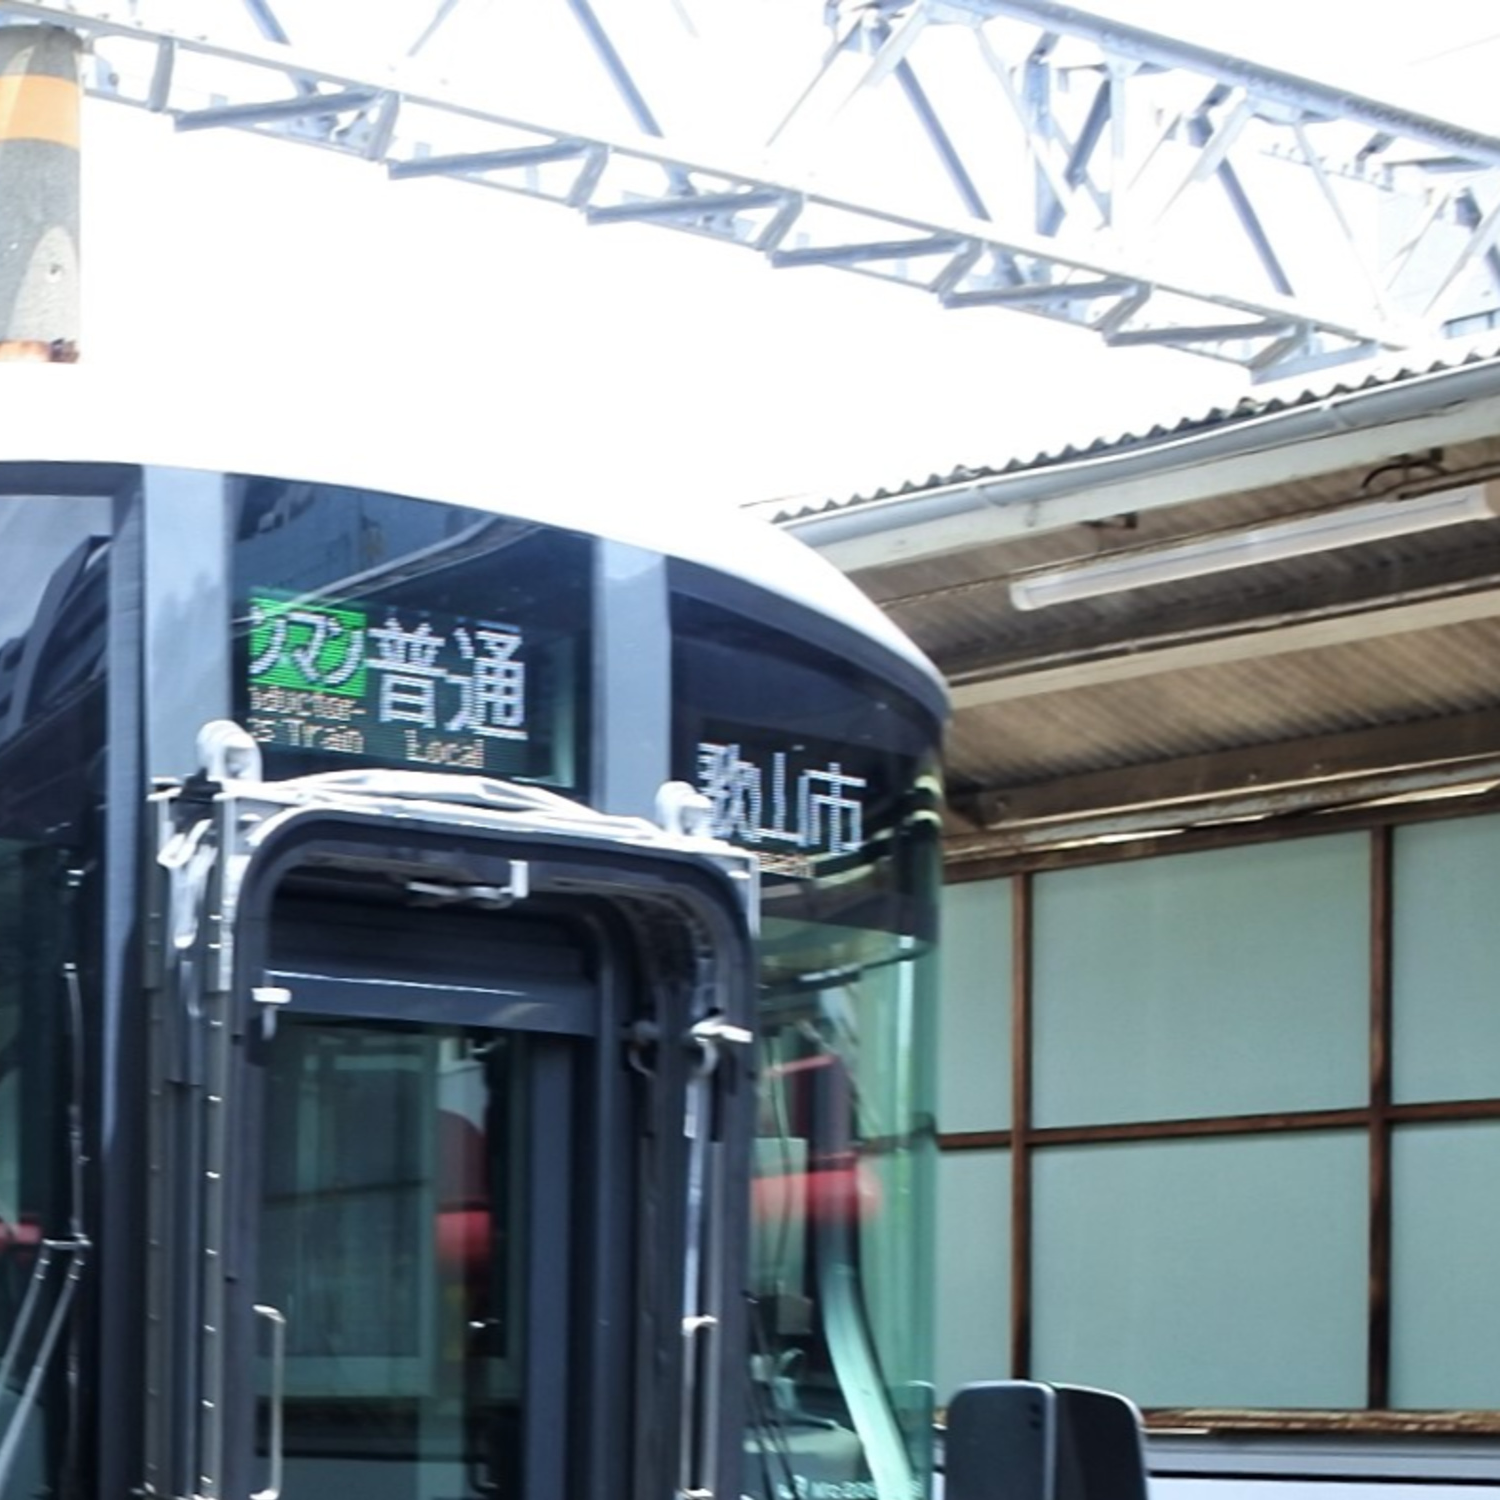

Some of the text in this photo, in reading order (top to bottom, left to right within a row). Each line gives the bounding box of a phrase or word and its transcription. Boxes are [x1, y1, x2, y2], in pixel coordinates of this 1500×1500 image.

[366, 611, 529, 741] 普通
[282, 718, 365, 754] Train
[404, 729, 485, 769] Local
